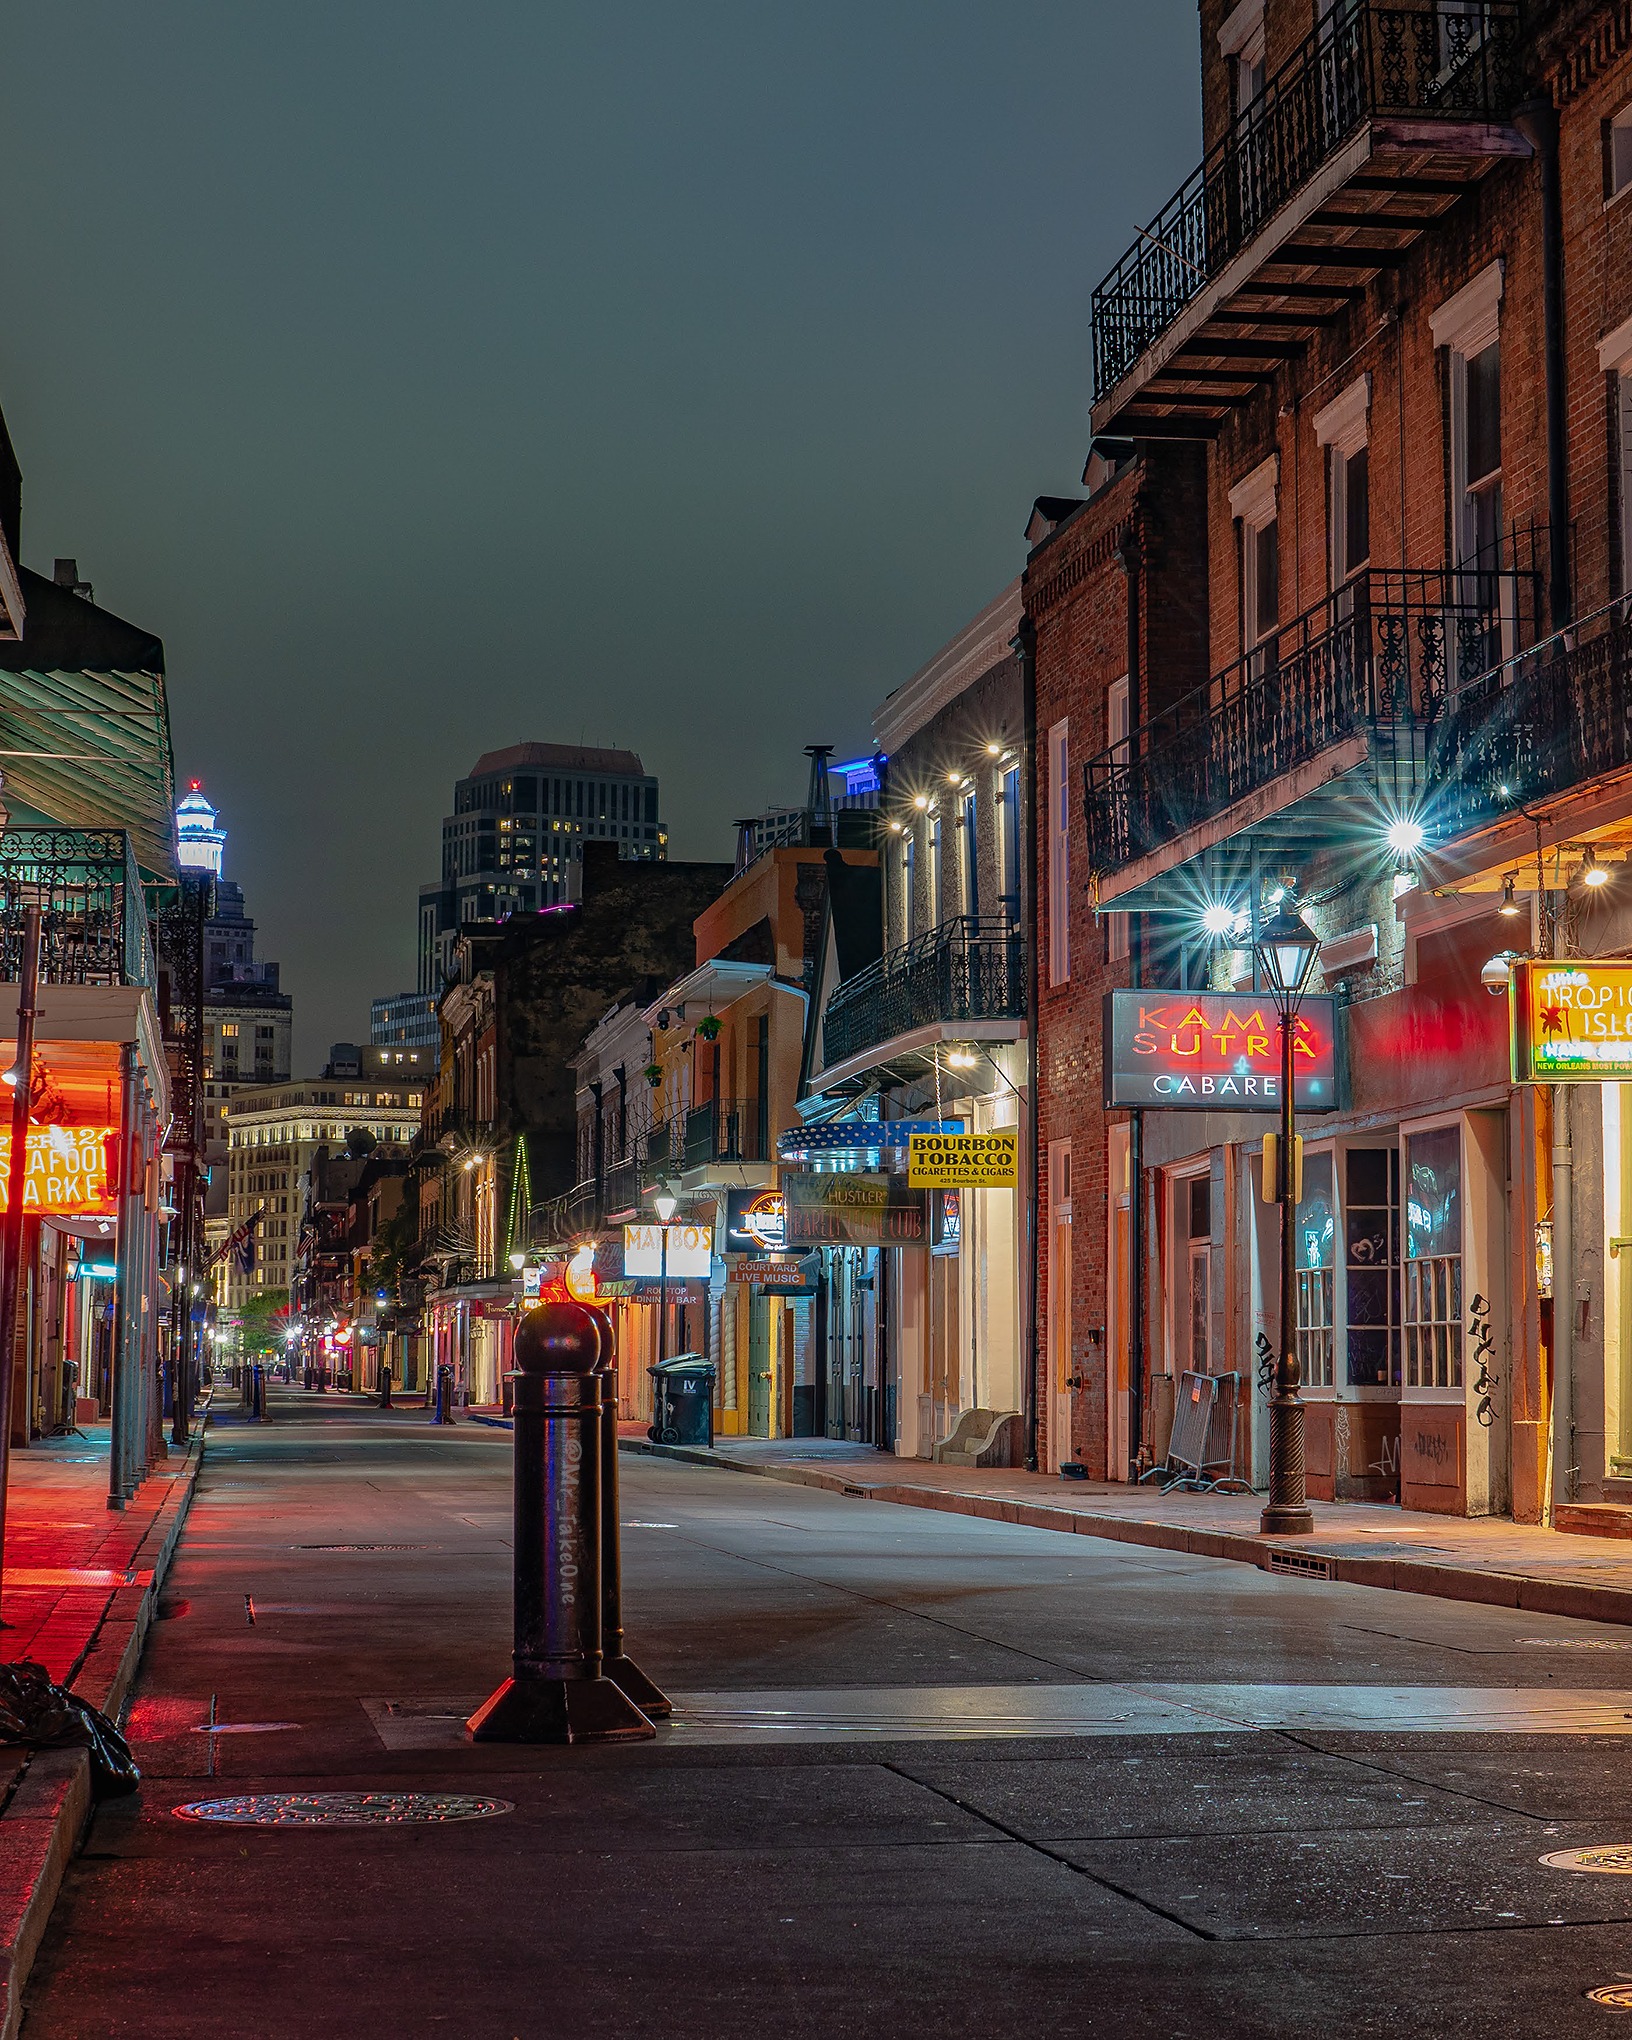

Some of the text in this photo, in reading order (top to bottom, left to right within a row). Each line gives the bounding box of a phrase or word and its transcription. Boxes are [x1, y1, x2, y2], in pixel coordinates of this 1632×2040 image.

[1132, 1031, 1317, 1059] SUTRA
[912, 1138, 1015, 1151] BOURBON
[914, 1152, 1012, 1165] TOBACCO
[912, 1167, 1015, 1176] CIGARETTES & CIGARS
[889, 1210, 922, 1239] CLUB
[738, 1263, 798, 1273] COURTYARD
[735, 1273, 800, 1283] LIVE MUSIC
[676, 1296, 697, 1304] BAR
